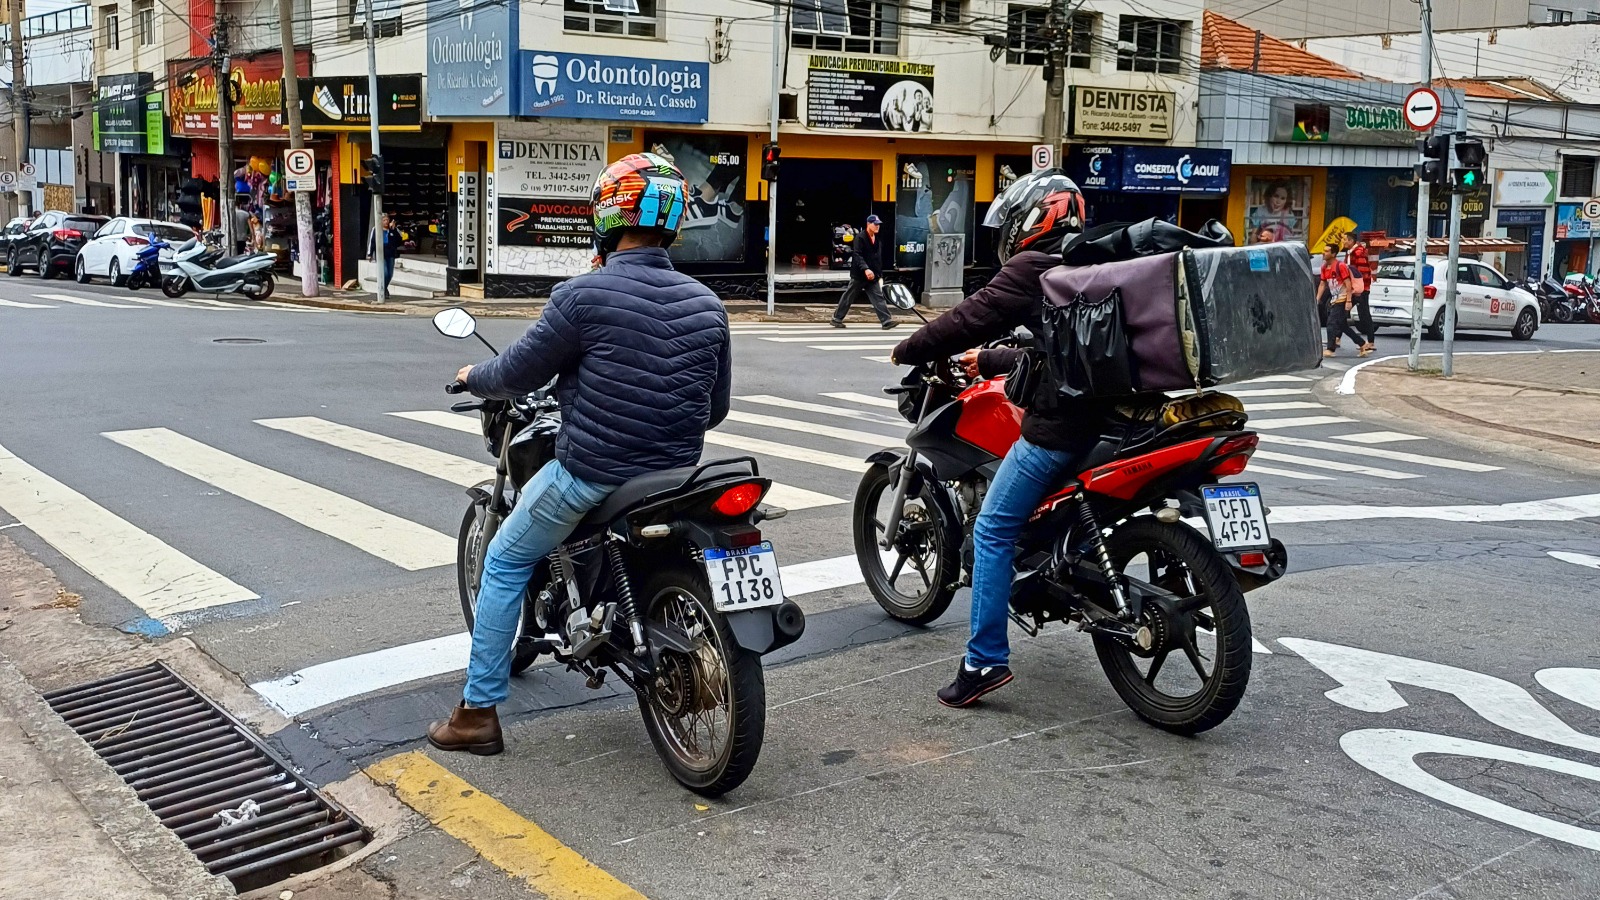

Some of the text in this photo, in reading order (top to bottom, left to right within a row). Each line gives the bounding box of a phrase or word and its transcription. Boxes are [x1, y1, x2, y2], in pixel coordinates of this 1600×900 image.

[433, 31, 502, 69] Odontologia
[809, 54, 848, 70] ADVOCACIA
[447, 71, 469, 88] Ricardo
[477, 70, 498, 88] Casseb
[566, 58, 701, 94] Odontologia
[343, 92, 368, 114] TÊNI
[550, 94, 565, 104] 1992
[577, 90, 697, 109] Dr. Ricardo A. Casseb
[1082, 90, 1167, 113] DENTISTA
[1091, 110, 1110, 118] Ricardo
[1345, 104, 1416, 131] BALLARI
[1082, 121, 1142, 132] Fone: 3442-5497
[515, 141, 602, 161] DENTISTA
[1039, 151, 1046, 164] E
[295, 156, 304, 169] E
[1134, 164, 1175, 174] CONSERTA
[525, 171, 590, 182] TEL. 3442-5497
[1193, 165, 1219, 177] AQUI!
[1085, 177, 1106, 185] AQUI!
[543, 184, 589, 194] 97107-5497
[1463, 202, 1484, 212] OURO
[1590, 204, 1598, 215] E
[466, 176, 476, 266] DENTISTA
[534, 223, 573, 231] TRABALHISTA
[552, 236, 591, 244] 3701-1644
[1122, 461, 1153, 476] YAMAHA
[1219, 499, 1251, 519] CFD
[1221, 520, 1262, 542] 4F95
[726, 548, 752, 557] BRASIL
[722, 555, 763, 581] FPC
